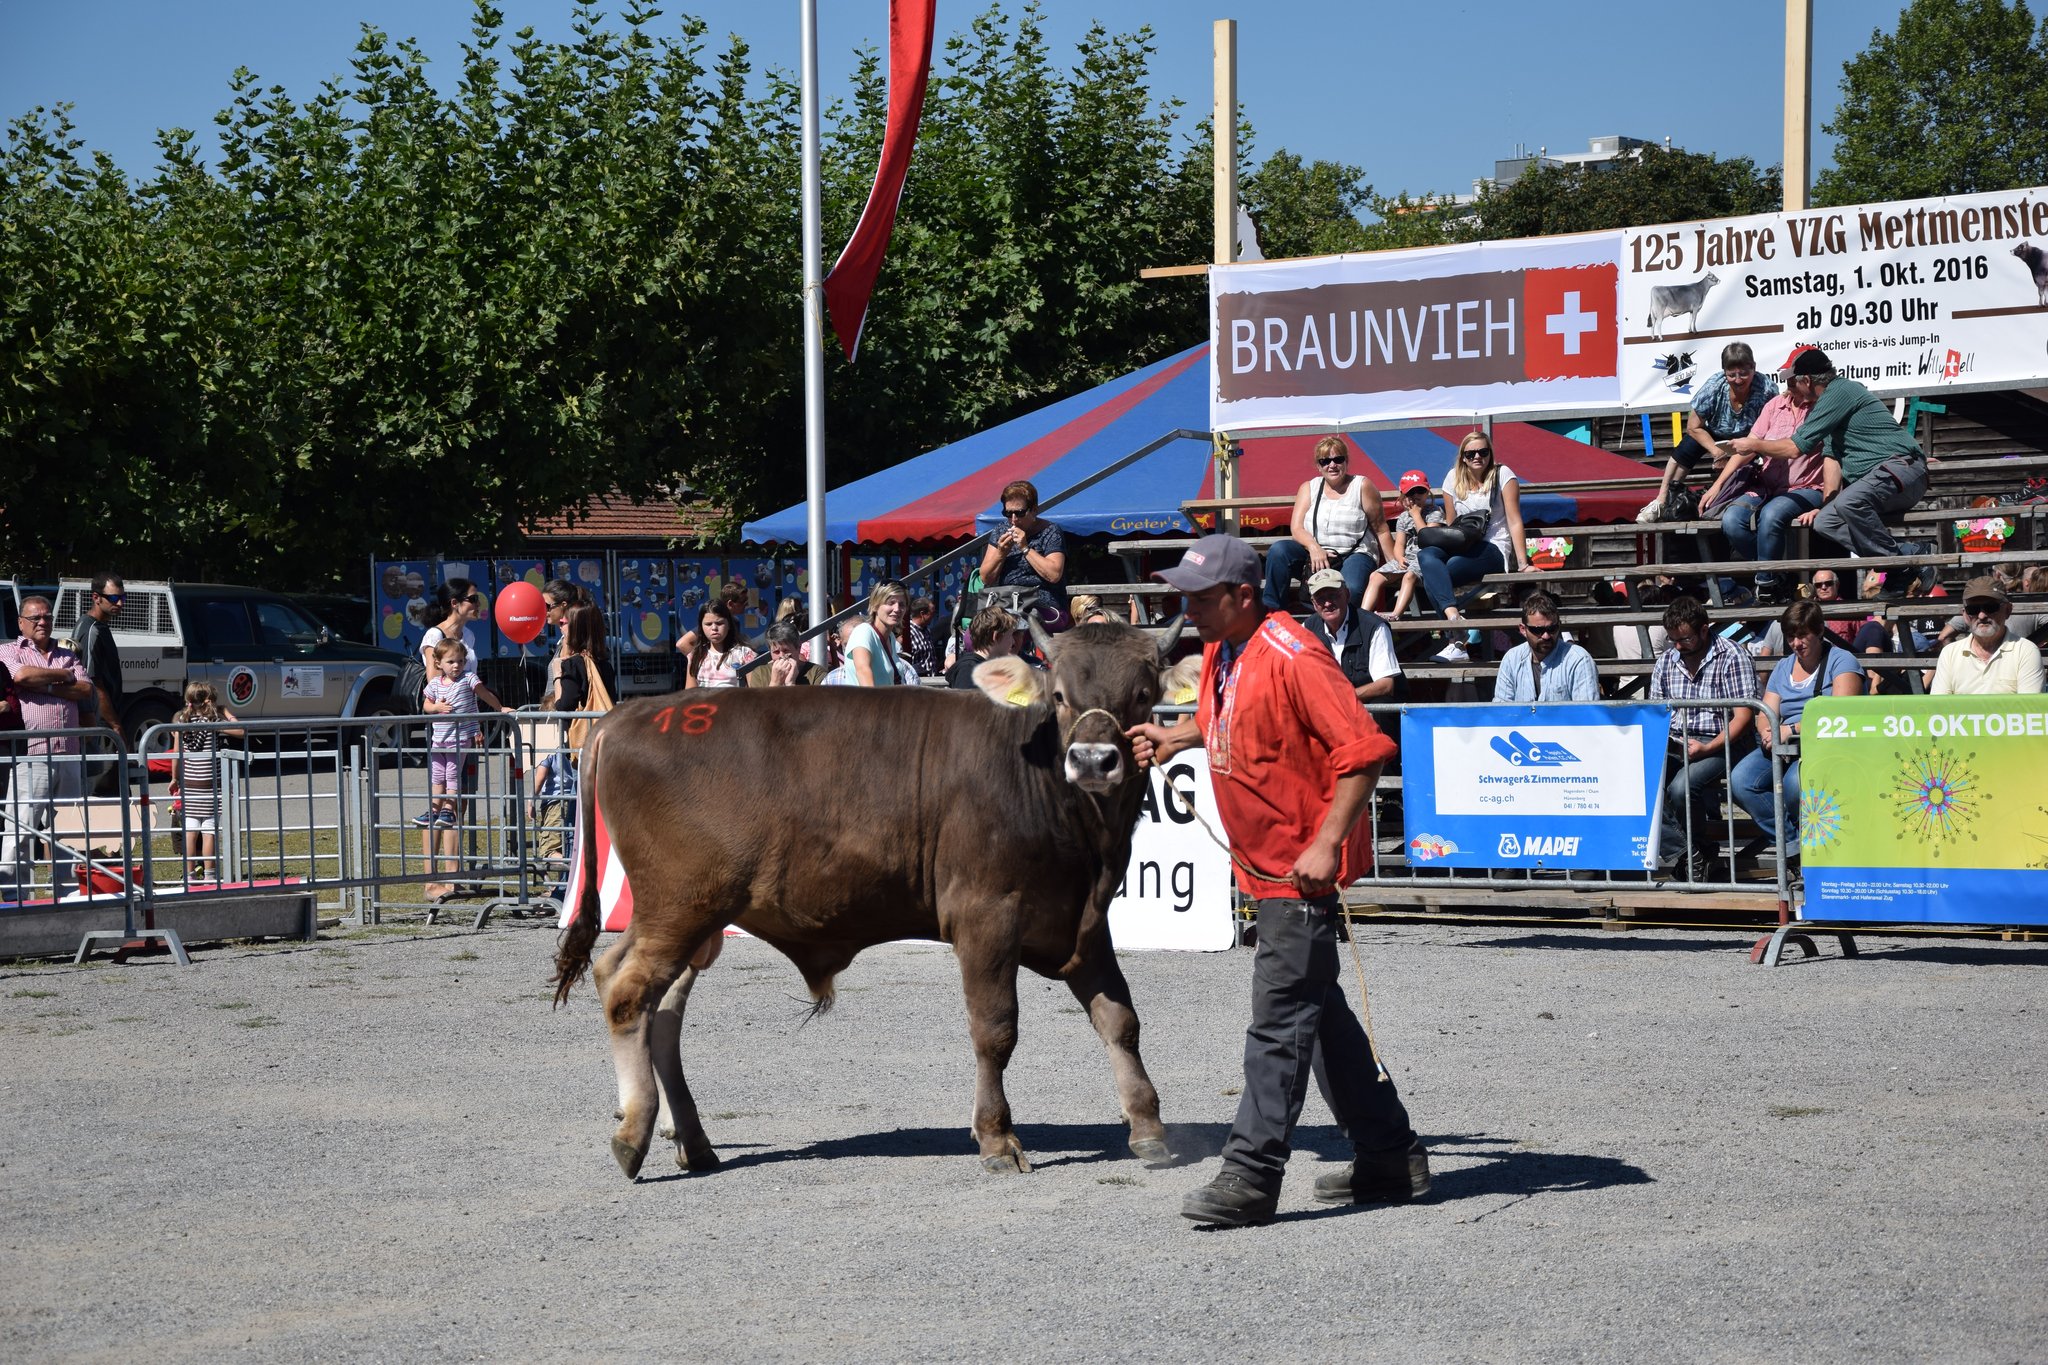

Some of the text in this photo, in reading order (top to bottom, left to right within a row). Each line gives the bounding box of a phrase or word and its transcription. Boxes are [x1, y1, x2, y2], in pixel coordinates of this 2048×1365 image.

[1630, 231, 1684, 273] 125
[1693, 226, 1776, 273] Jahre
[1786, 215, 1848, 258] VZG
[1745, 255, 1989, 299] Samstag, 1. Okt. 2016
[1796, 298, 1939, 330] ab 09.30 Uhr
[1231, 298, 1516, 375] BRAUNVIEH
[1794, 332, 1940, 352] Skacher vis-à-vis Jump-In
[1885, 361, 1912, 377] mit:
[1111, 515, 1181, 530] Greter's
[652, 703, 719, 735] 18
[1817, 716, 1857, 738] 22.
[1882, 715, 1923, 737] 30.
[1928, 713, 2048, 737] OKTOBE
[1142, 763, 1196, 825] AG
[1479, 794, 1515, 805] cc-ag.ch
[1523, 836, 1580, 856] MAPEI
